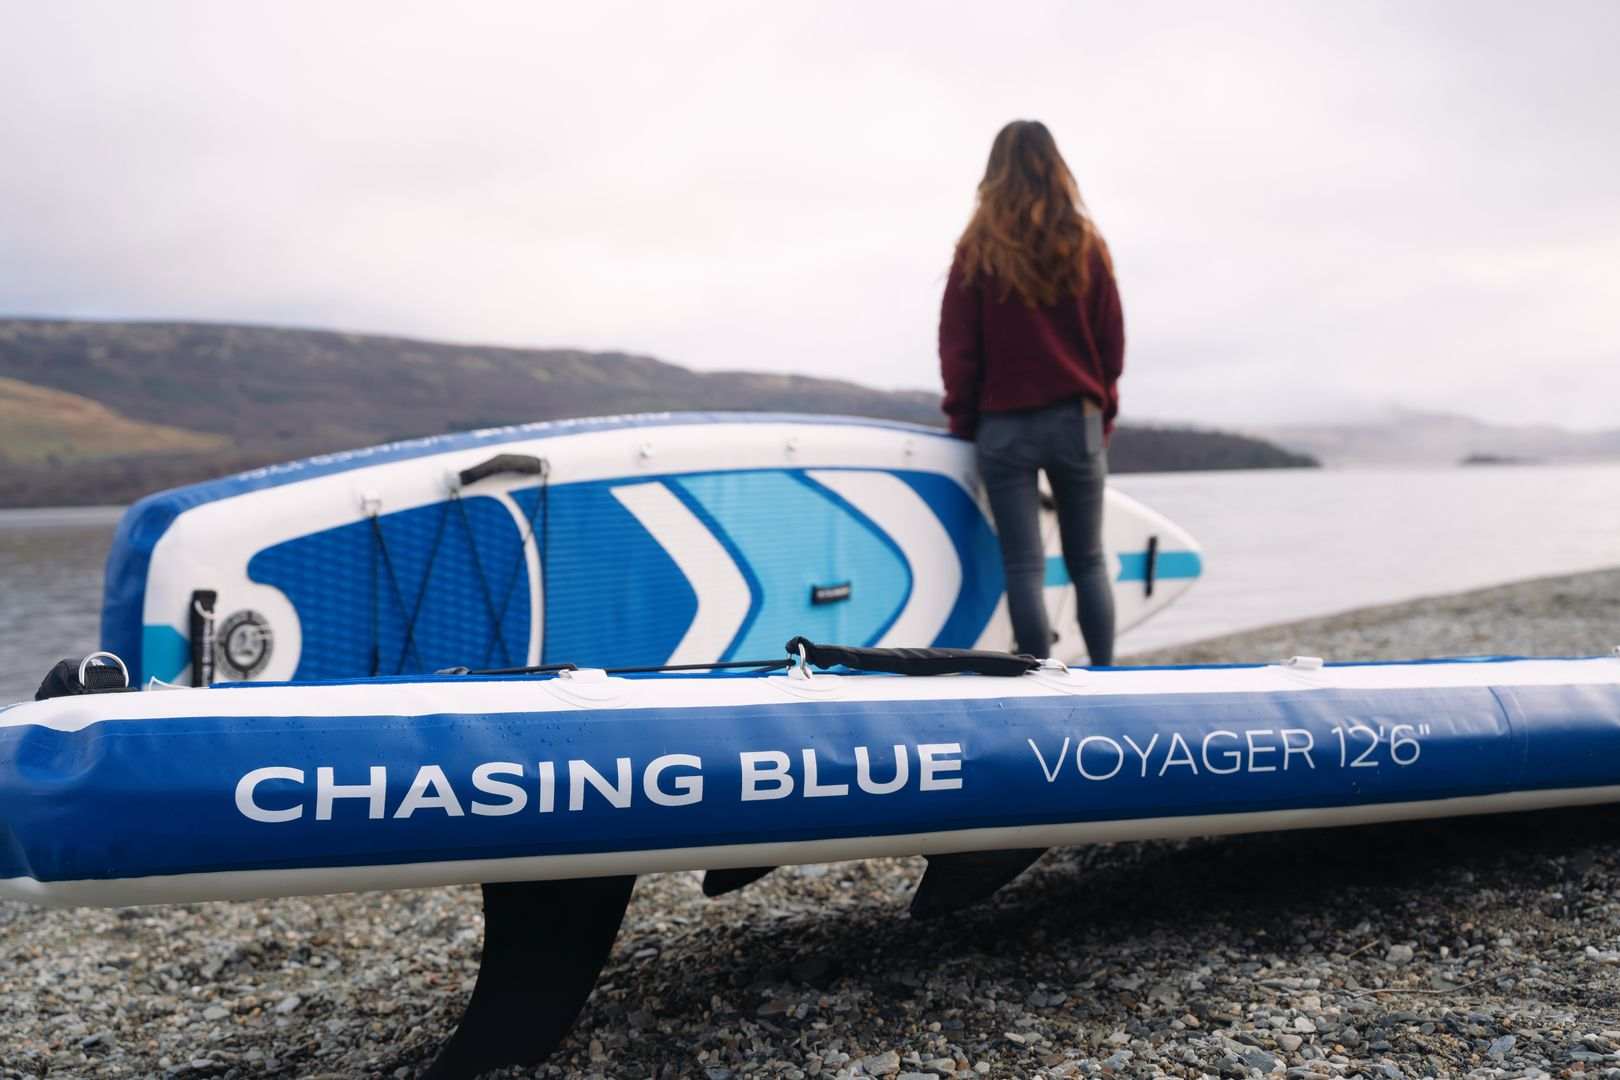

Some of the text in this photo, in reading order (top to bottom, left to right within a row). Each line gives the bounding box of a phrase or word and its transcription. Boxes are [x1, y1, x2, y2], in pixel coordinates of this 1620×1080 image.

[235, 724, 1431, 823] CHASING BLUE VOYAGER 12'6"
